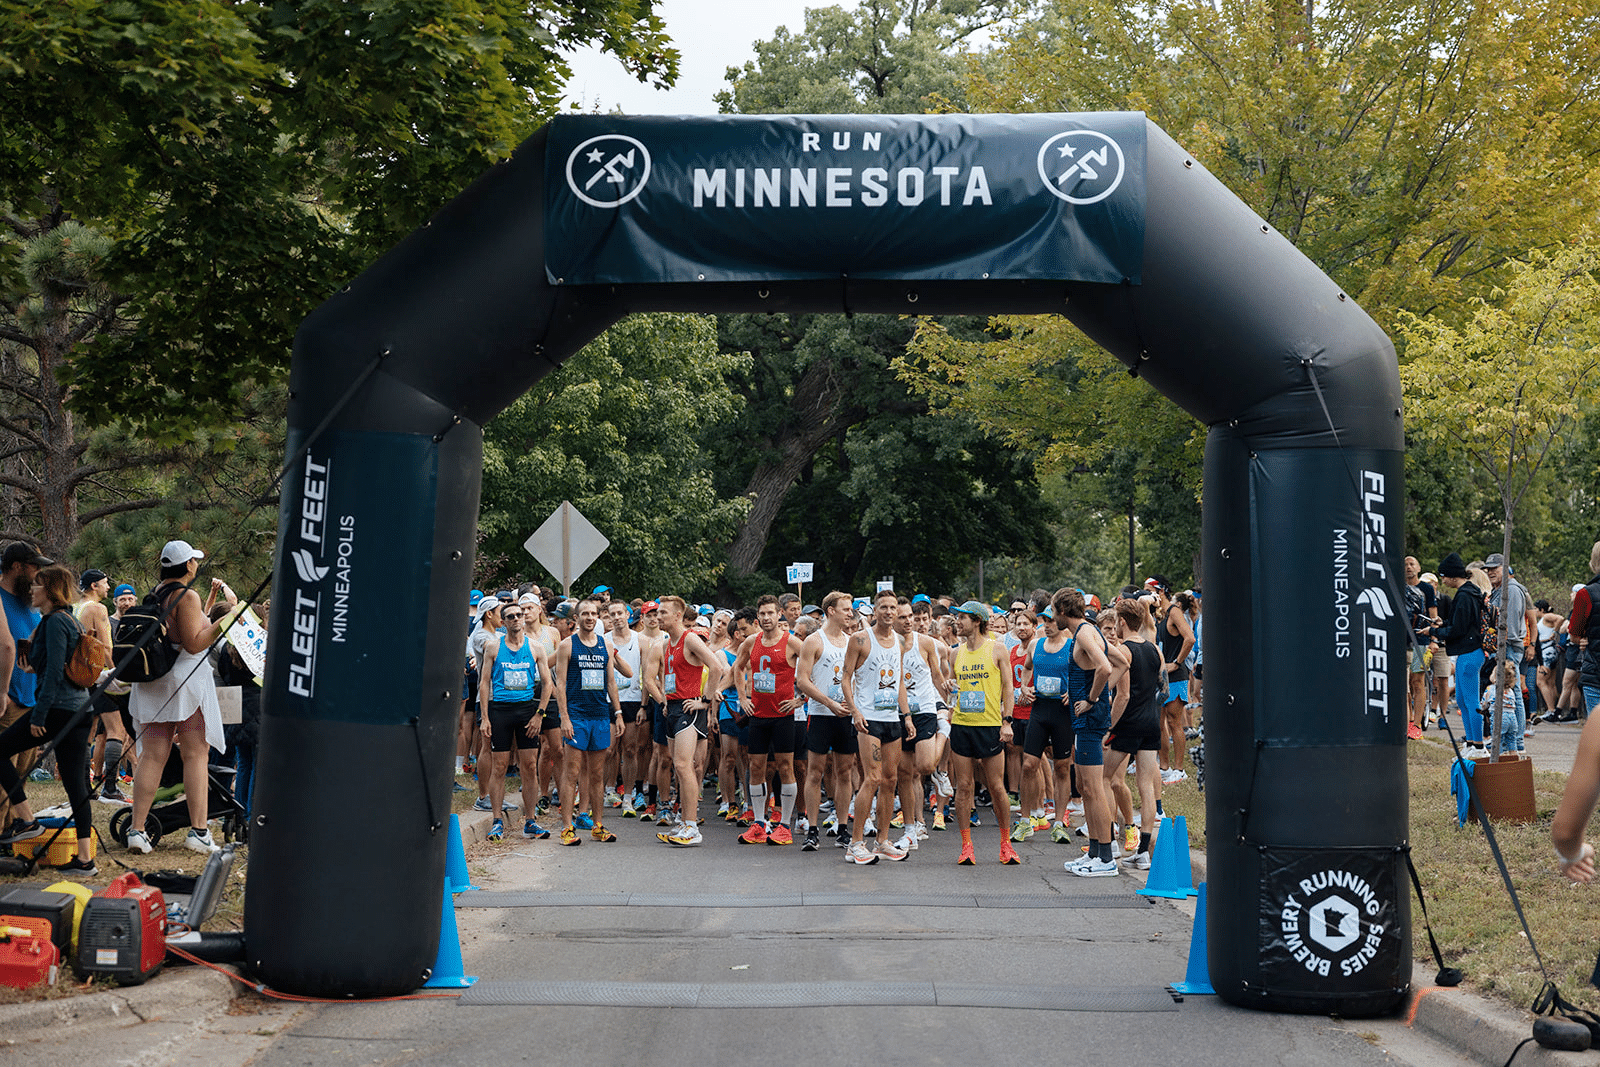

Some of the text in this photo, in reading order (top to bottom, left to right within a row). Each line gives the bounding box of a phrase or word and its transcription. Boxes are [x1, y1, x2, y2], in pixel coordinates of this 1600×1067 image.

[693, 165, 993, 208] MINNESOTA
[802, 131, 882, 152] RUN
[288, 453, 326, 697] FLEET FEET
[331, 514, 355, 642] MINNEAPOLIS
[1333, 529, 1350, 658] MINNEAPOLIS
[759, 655, 771, 674] C
[965, 699, 979, 707] 125
[1367, 627, 1388, 717] FEET
[1281, 870, 1384, 977] BREWERY RUNNING SERIES
